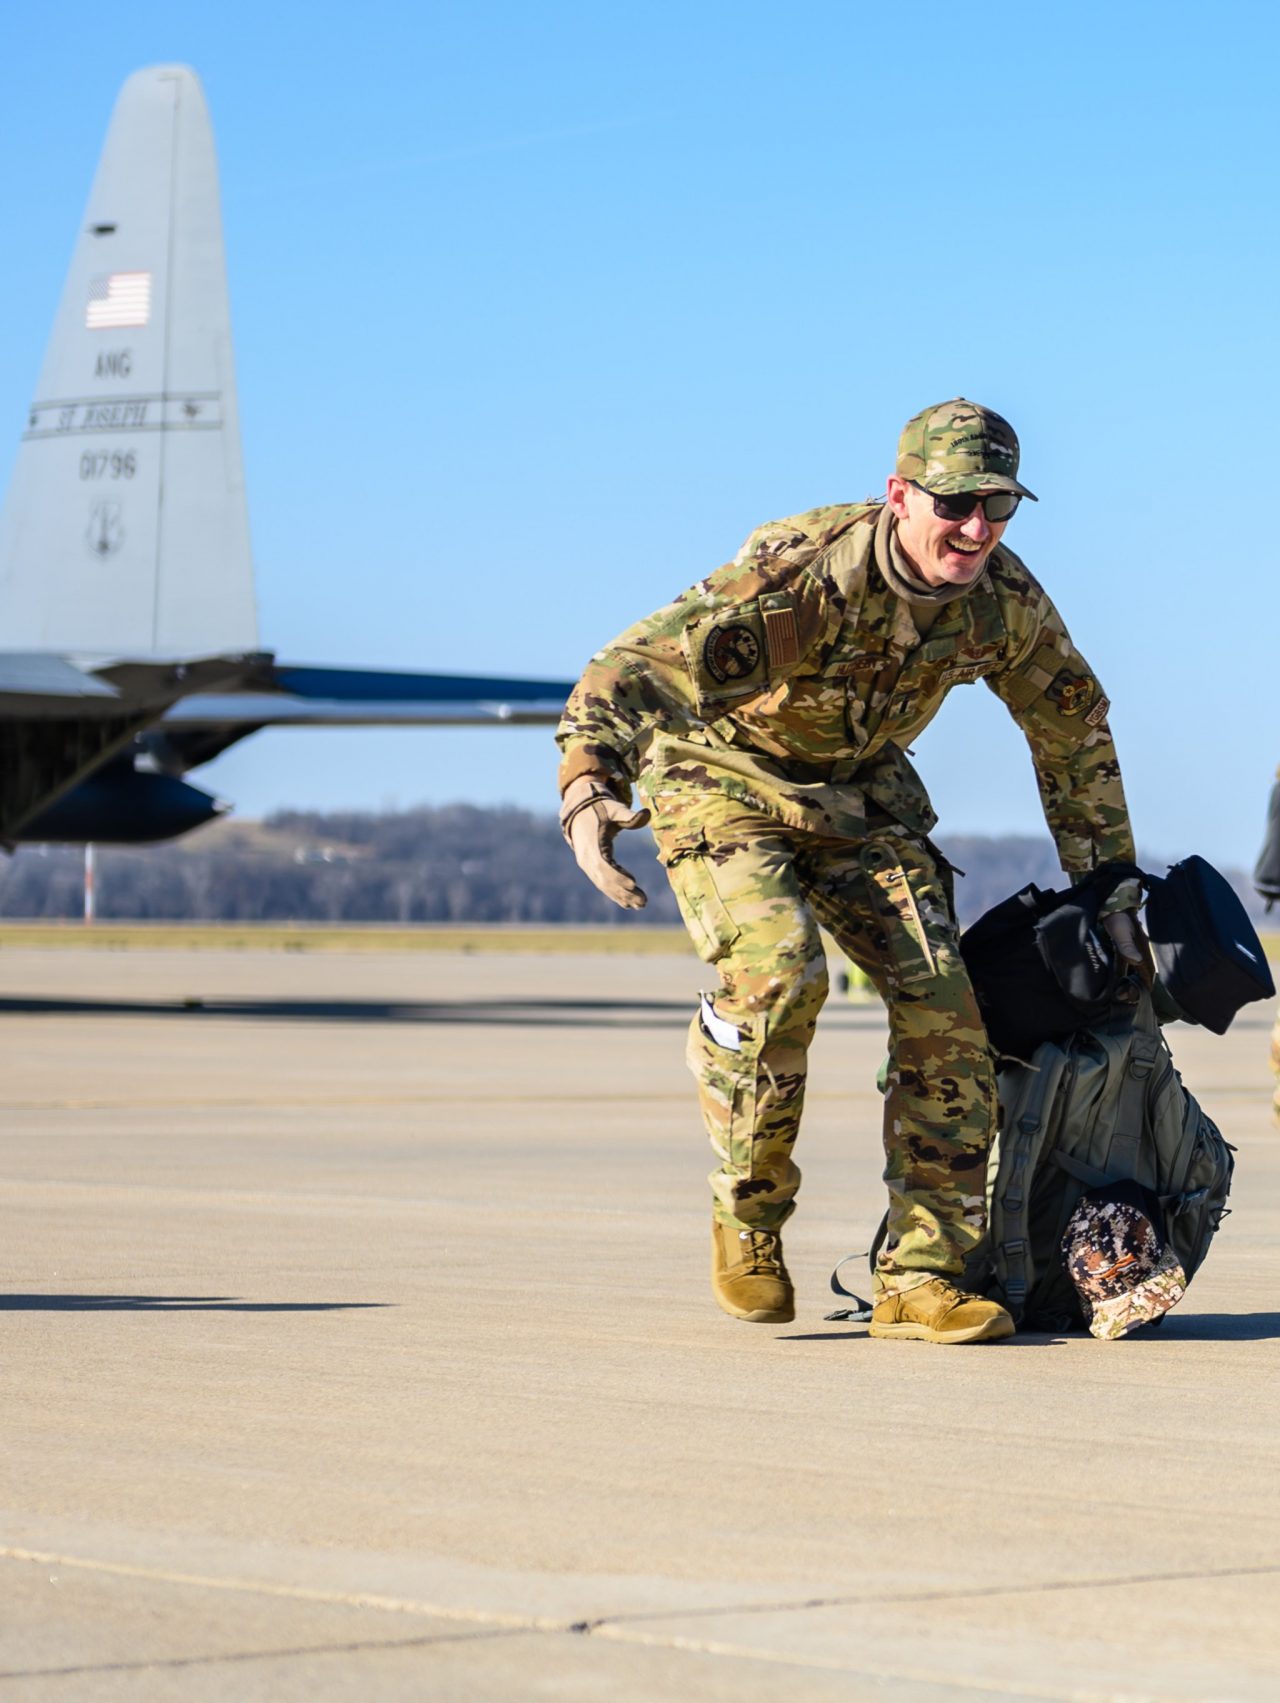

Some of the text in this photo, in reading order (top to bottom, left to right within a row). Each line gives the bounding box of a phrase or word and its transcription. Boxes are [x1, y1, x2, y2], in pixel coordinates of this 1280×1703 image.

[94, 350, 132, 379] ANG
[81, 401, 150, 429] JOSEPH
[79, 449, 137, 481] 01796
